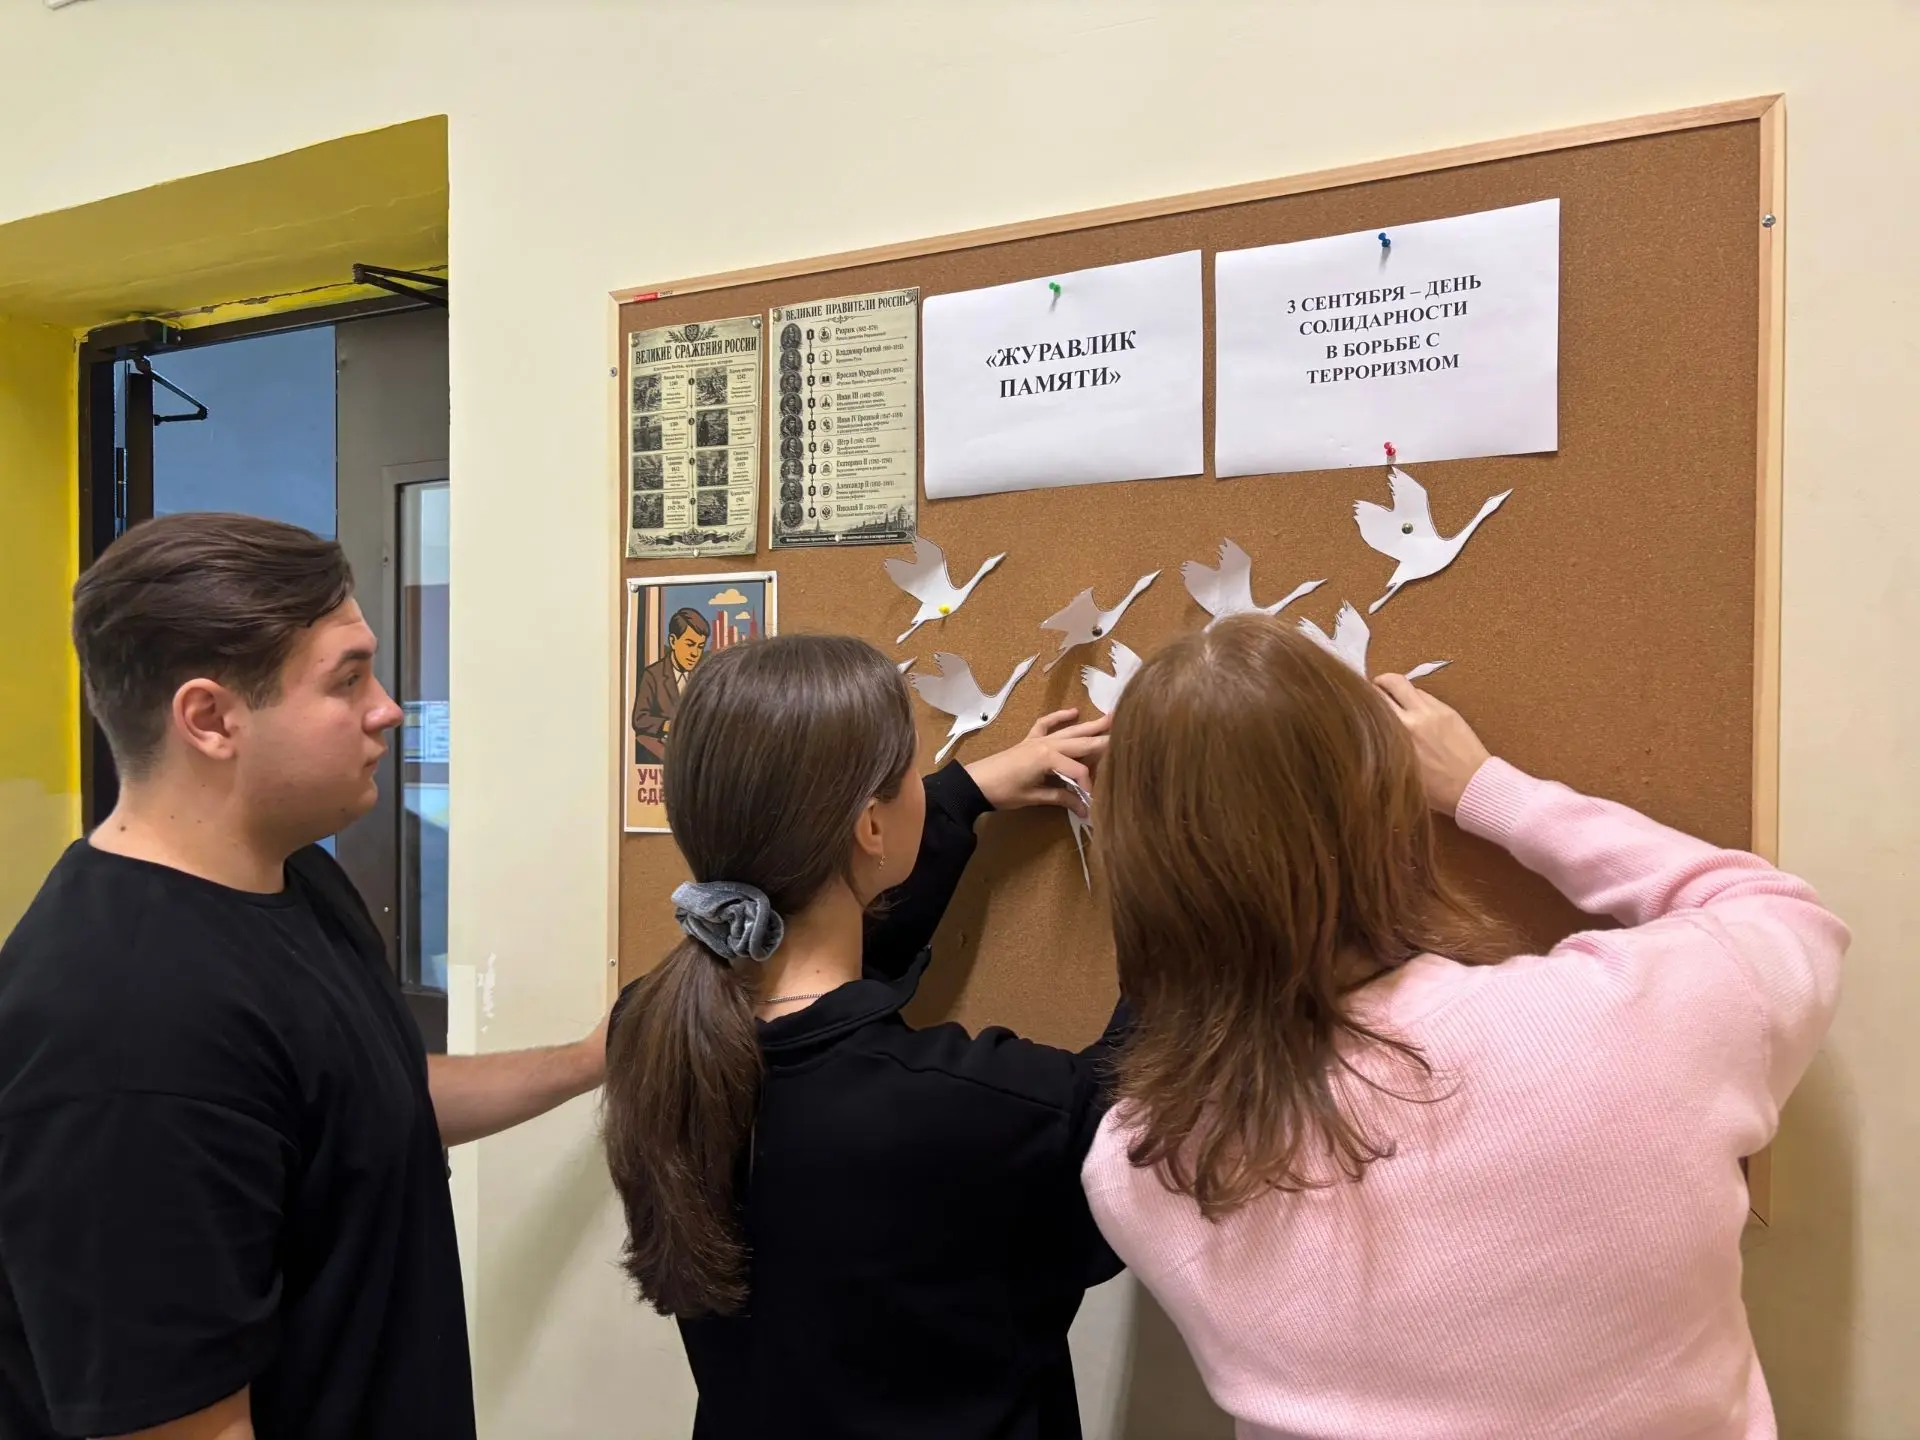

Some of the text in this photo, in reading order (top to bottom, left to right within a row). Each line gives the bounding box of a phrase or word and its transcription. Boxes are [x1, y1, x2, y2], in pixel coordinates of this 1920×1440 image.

[786, 305, 822, 321] ВЕЛИКИЕ
[826, 299, 876, 315] ПРАВИТЕЛИ
[1286, 300, 1296, 314] 3
[1301, 286, 1406, 312] СЕНТЯБРЯ
[1425, 274, 1482, 299] ДЕНЬ
[1299, 301, 1468, 336] СОЛИДАРНОСТИ
[635, 336, 757, 364] ВЕЛИКИЕ СРАЖЕНИЯ РОССИИ
[985, 329, 1137, 368] «ЖУРАВЛИК
[1326, 332, 1440, 359] В БОРЬБЕ С
[999, 366, 1122, 398] ПАМЯТИ»
[1306, 353, 1460, 385] ТЕРРОРИЗМОМ
